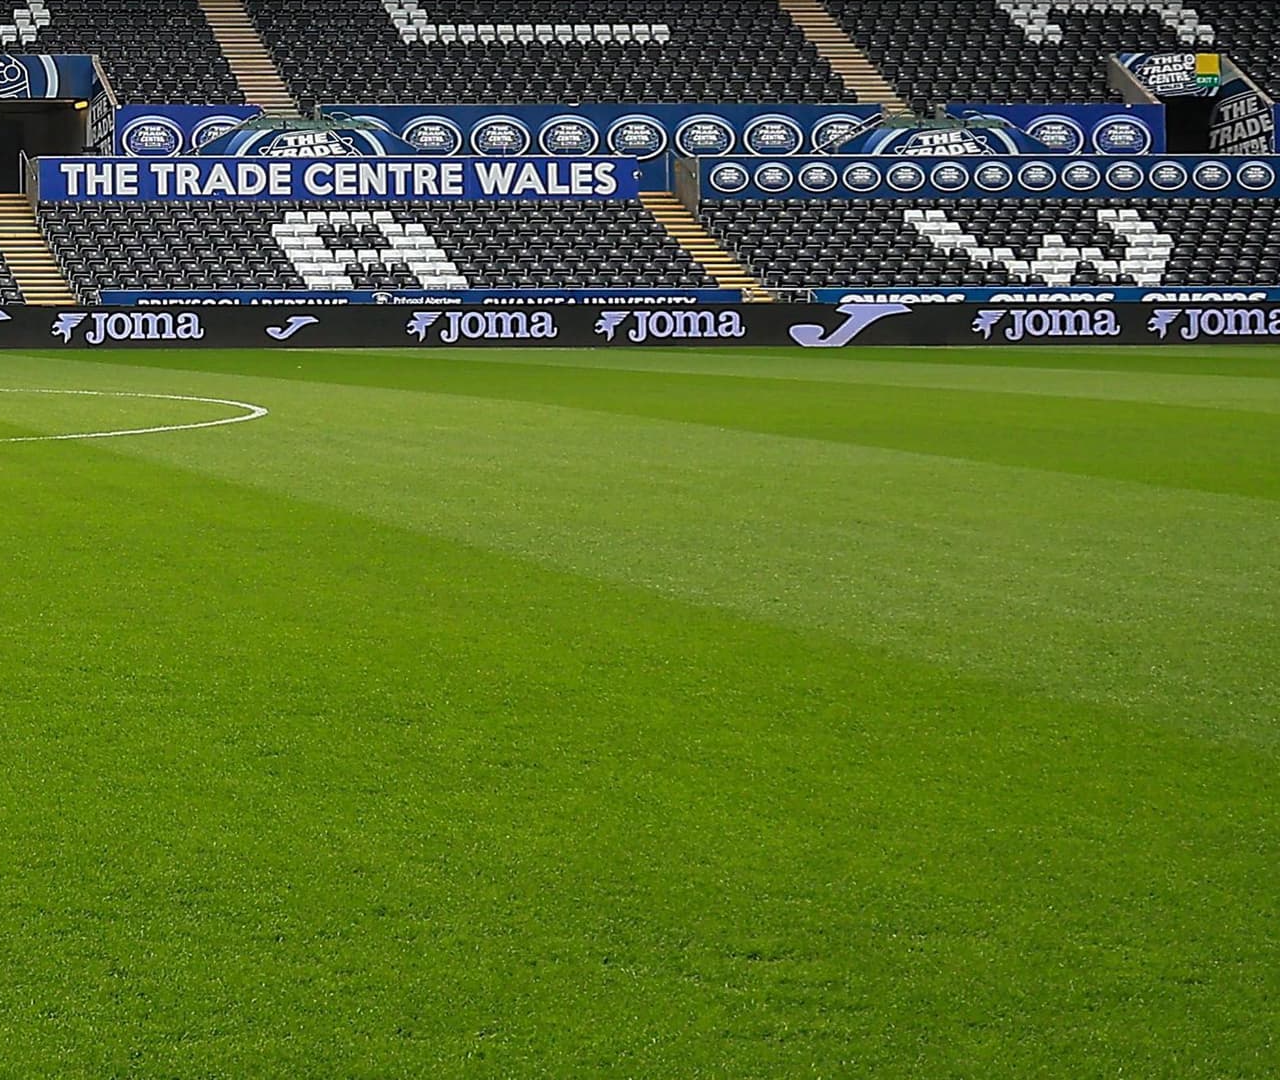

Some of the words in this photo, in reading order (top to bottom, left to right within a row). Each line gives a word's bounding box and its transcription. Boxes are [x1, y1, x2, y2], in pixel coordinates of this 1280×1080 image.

[1152, 55, 1181, 64] THE
[1149, 71, 1191, 85] CENTRE
[1220, 96, 1258, 121] THE
[282, 132, 327, 145] THE
[918, 131, 962, 146] THE
[1209, 114, 1274, 149] TRADE
[61, 164, 137, 195] THE
[151, 164, 290, 195] TRADE
[305, 163, 462, 195] CENTRE
[475, 163, 616, 195] WALES
